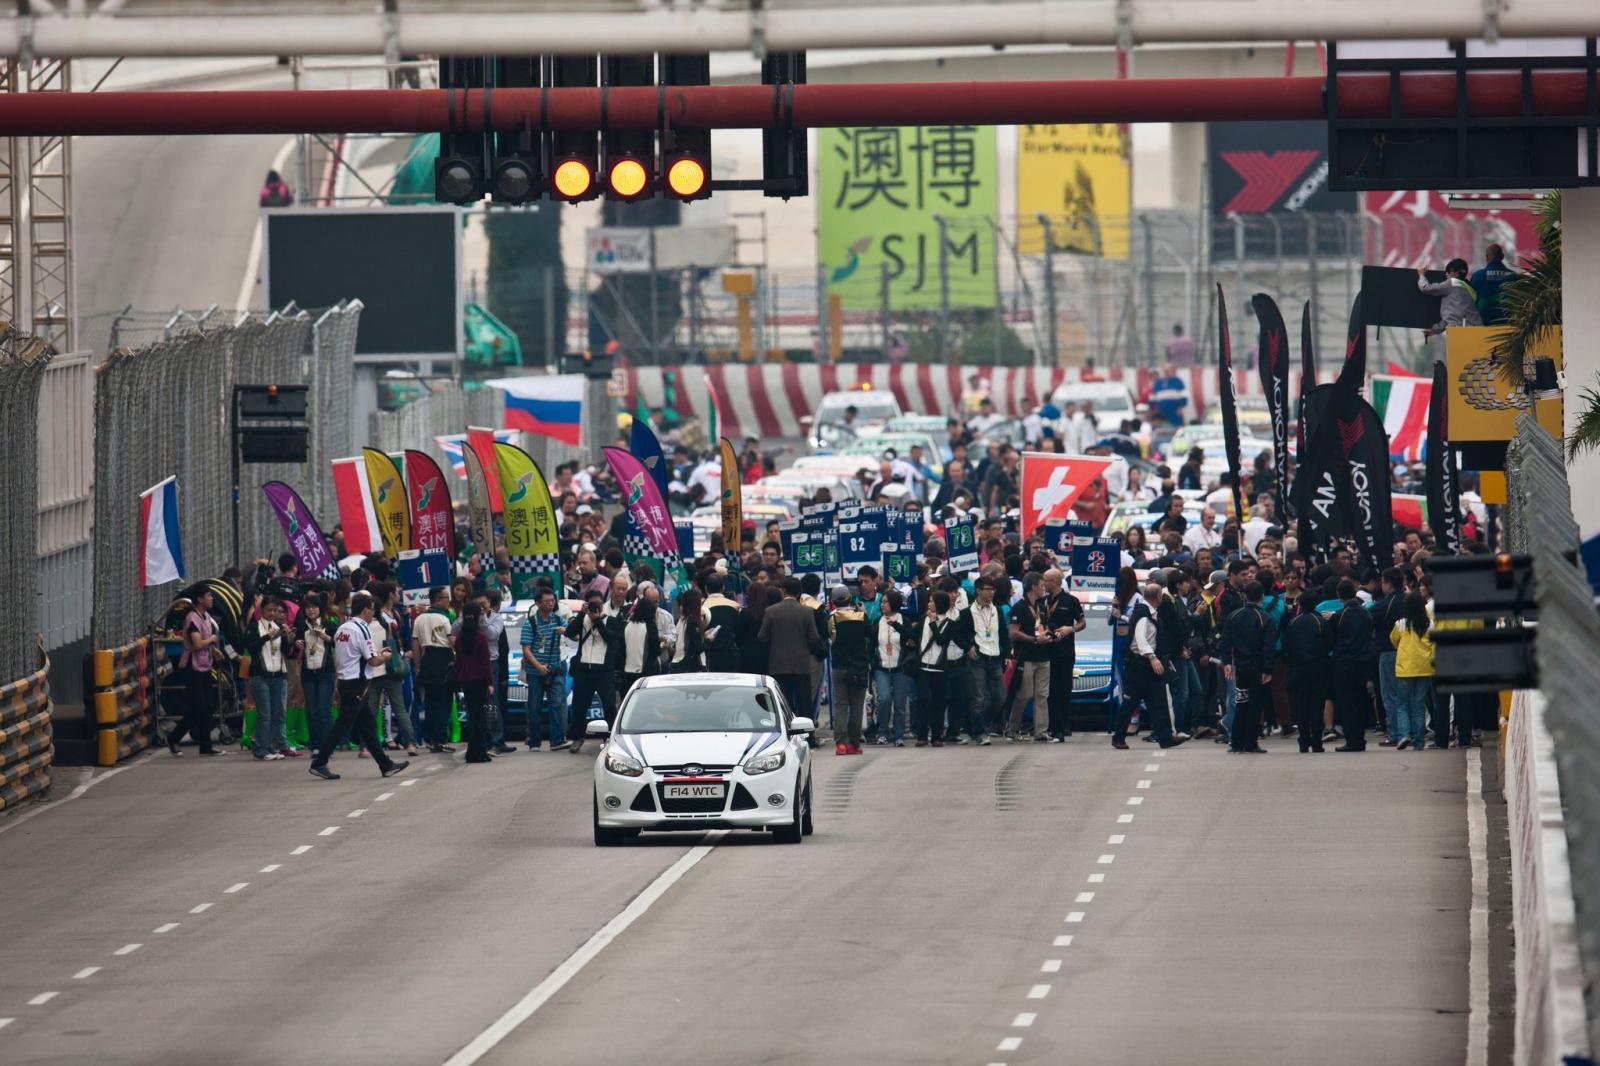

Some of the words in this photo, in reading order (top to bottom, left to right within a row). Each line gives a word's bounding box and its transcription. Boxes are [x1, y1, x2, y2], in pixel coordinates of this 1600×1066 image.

[834, 126, 981, 210] 澳博
[880, 233, 979, 292] SJM
[418, 511, 447, 534] 澳博
[508, 506, 547, 527] 澳博
[511, 527, 550, 549] SJM
[850, 537, 866, 552] 82
[302, 541, 326, 572] SJM
[797, 543, 824, 567] 55
[889, 555, 910, 577] 51
[1087, 550, 1106, 573] 2
[417, 561, 431, 583] 1
[670, 787, 689, 796] F14
[692, 786, 718, 796] WTC
